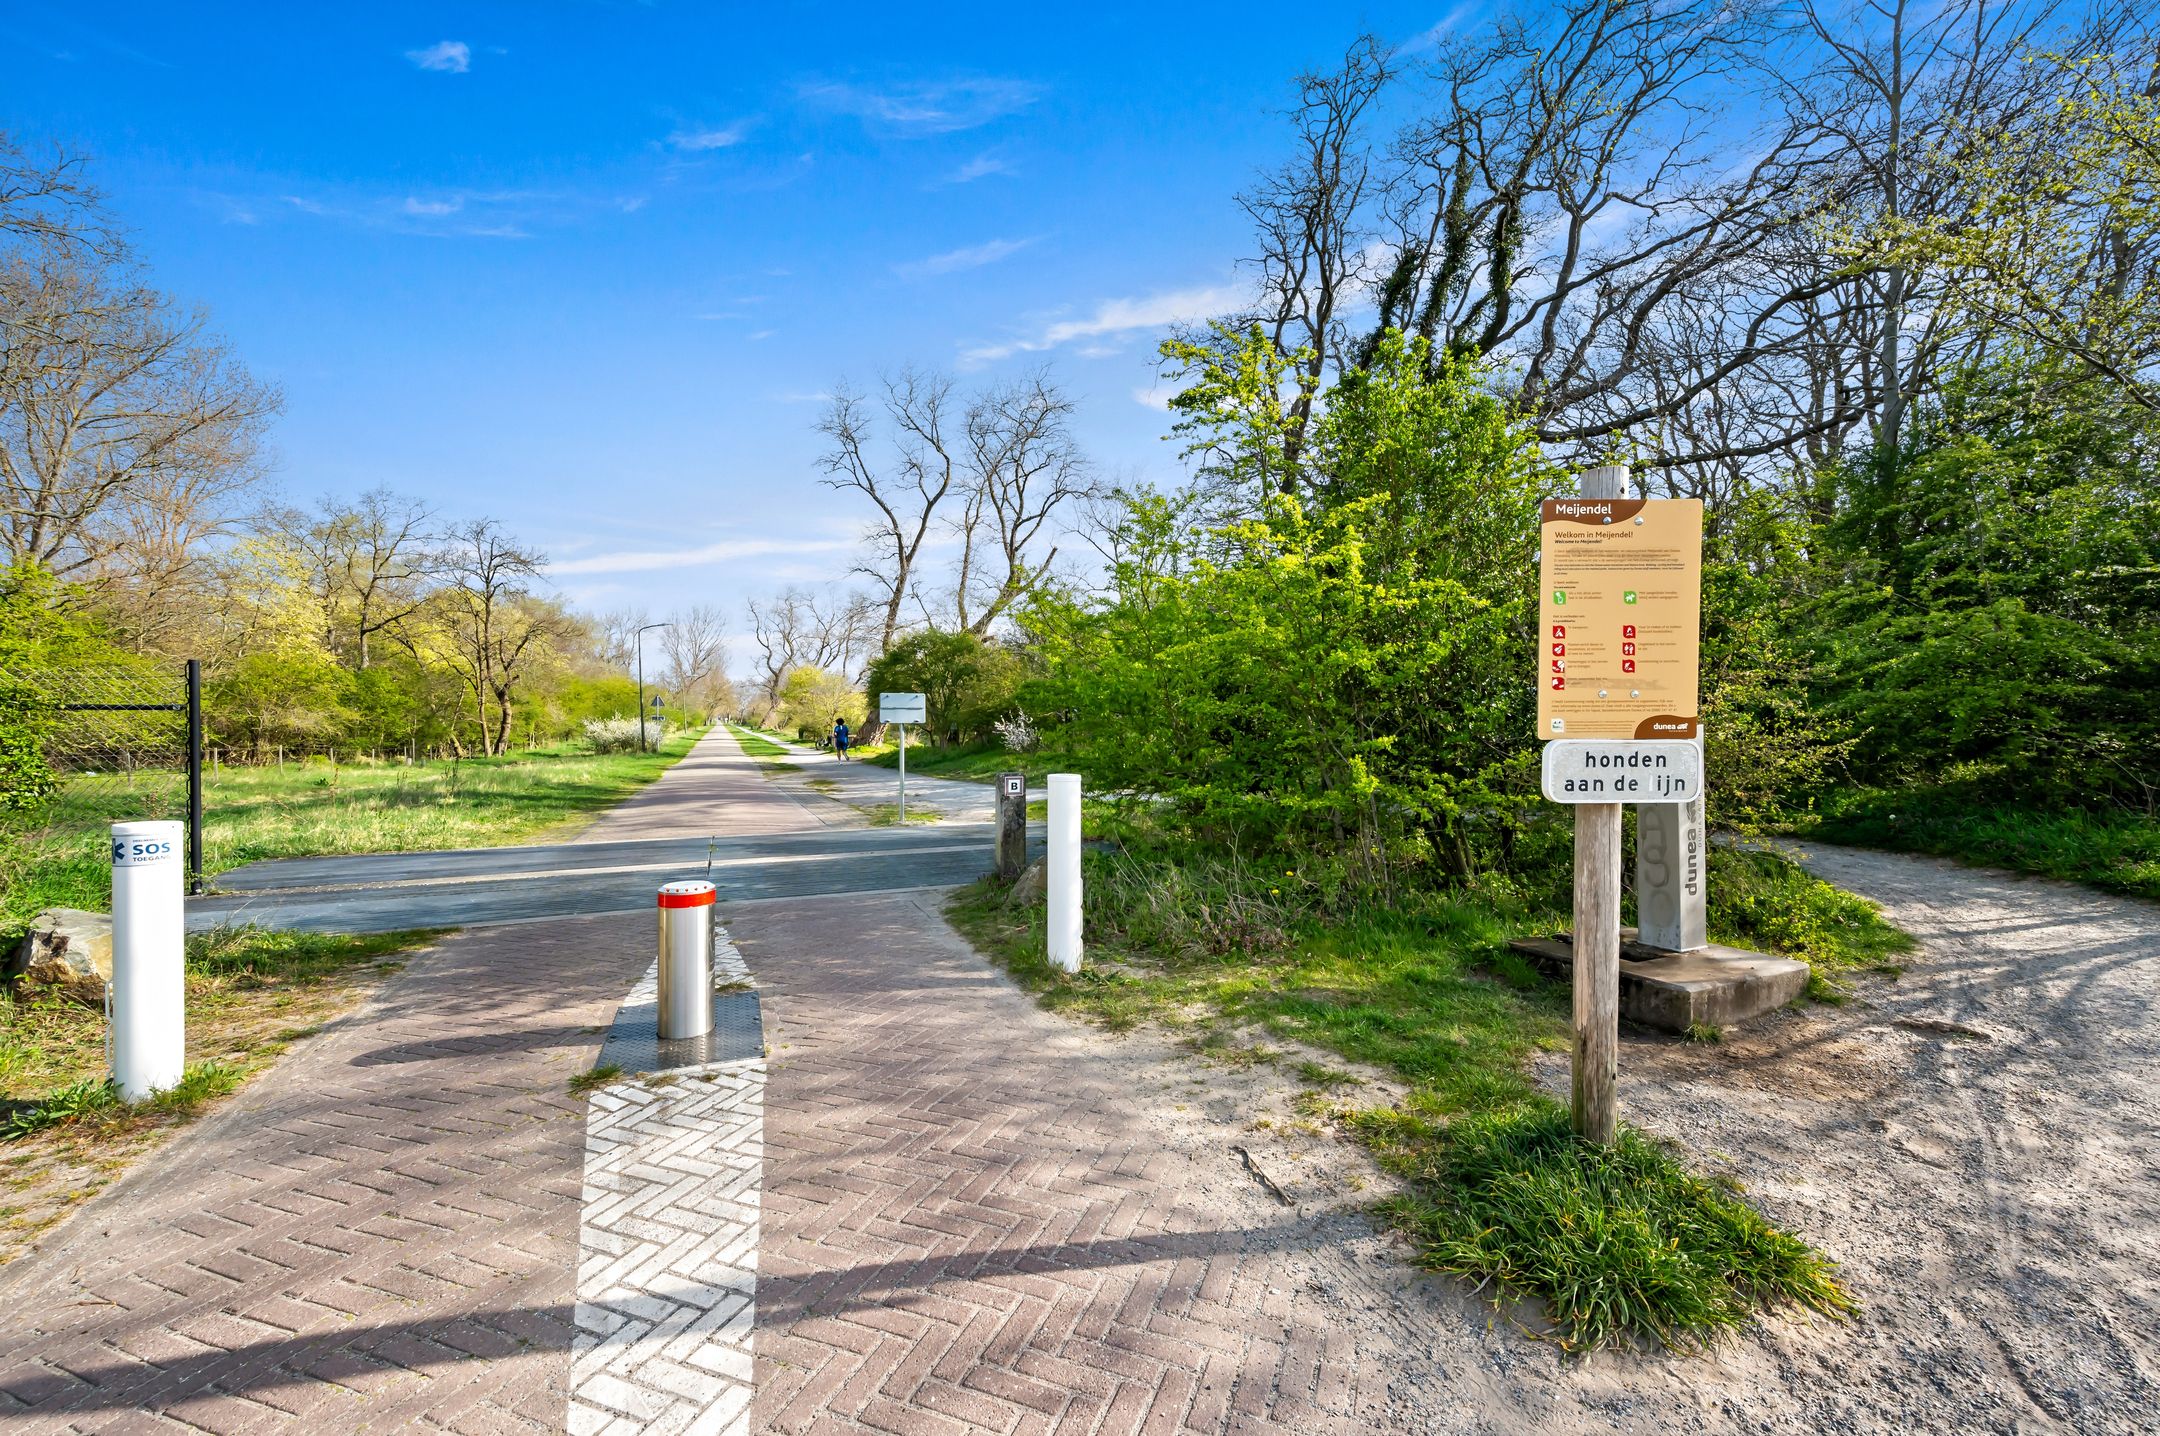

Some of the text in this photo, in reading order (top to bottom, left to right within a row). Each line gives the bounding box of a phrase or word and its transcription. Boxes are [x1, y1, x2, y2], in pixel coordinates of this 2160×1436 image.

[1555, 503, 1612, 517] Meijendel
[1595, 531, 1633, 540] Meijendel!
[1653, 722, 1676, 730] dunea
[1585, 751, 1667, 768] honden
[1011, 782, 1018, 790] B
[1564, 778, 1604, 792] aan
[1614, 775, 1639, 792] de
[132, 842, 170, 856] SOS
[1684, 828, 1698, 896] dunea
